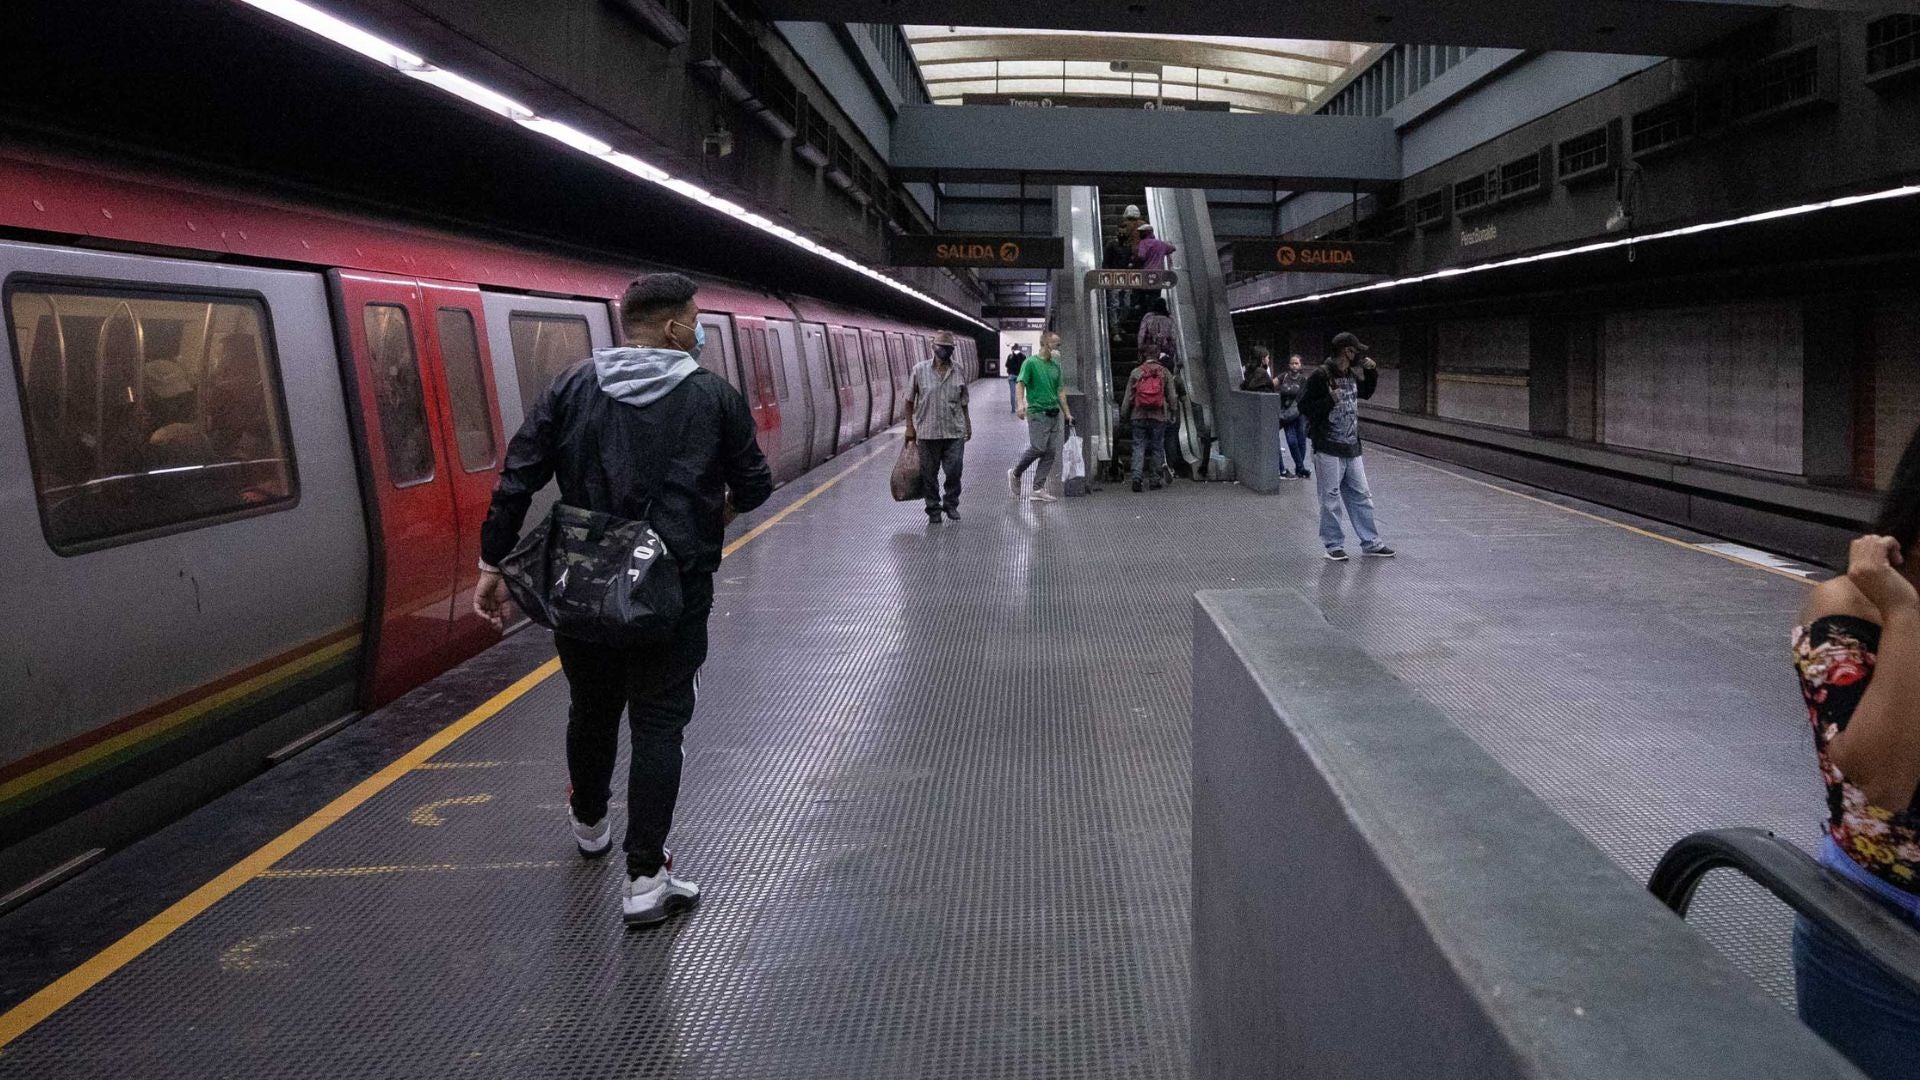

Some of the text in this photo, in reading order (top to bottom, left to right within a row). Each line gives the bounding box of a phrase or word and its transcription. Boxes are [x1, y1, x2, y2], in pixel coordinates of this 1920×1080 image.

[1009, 98, 1039, 108] Trenes
[1159, 104, 1186, 112] renes
[936, 243, 995, 259] SALIDA
[1300, 248, 1355, 264] SALIDA
